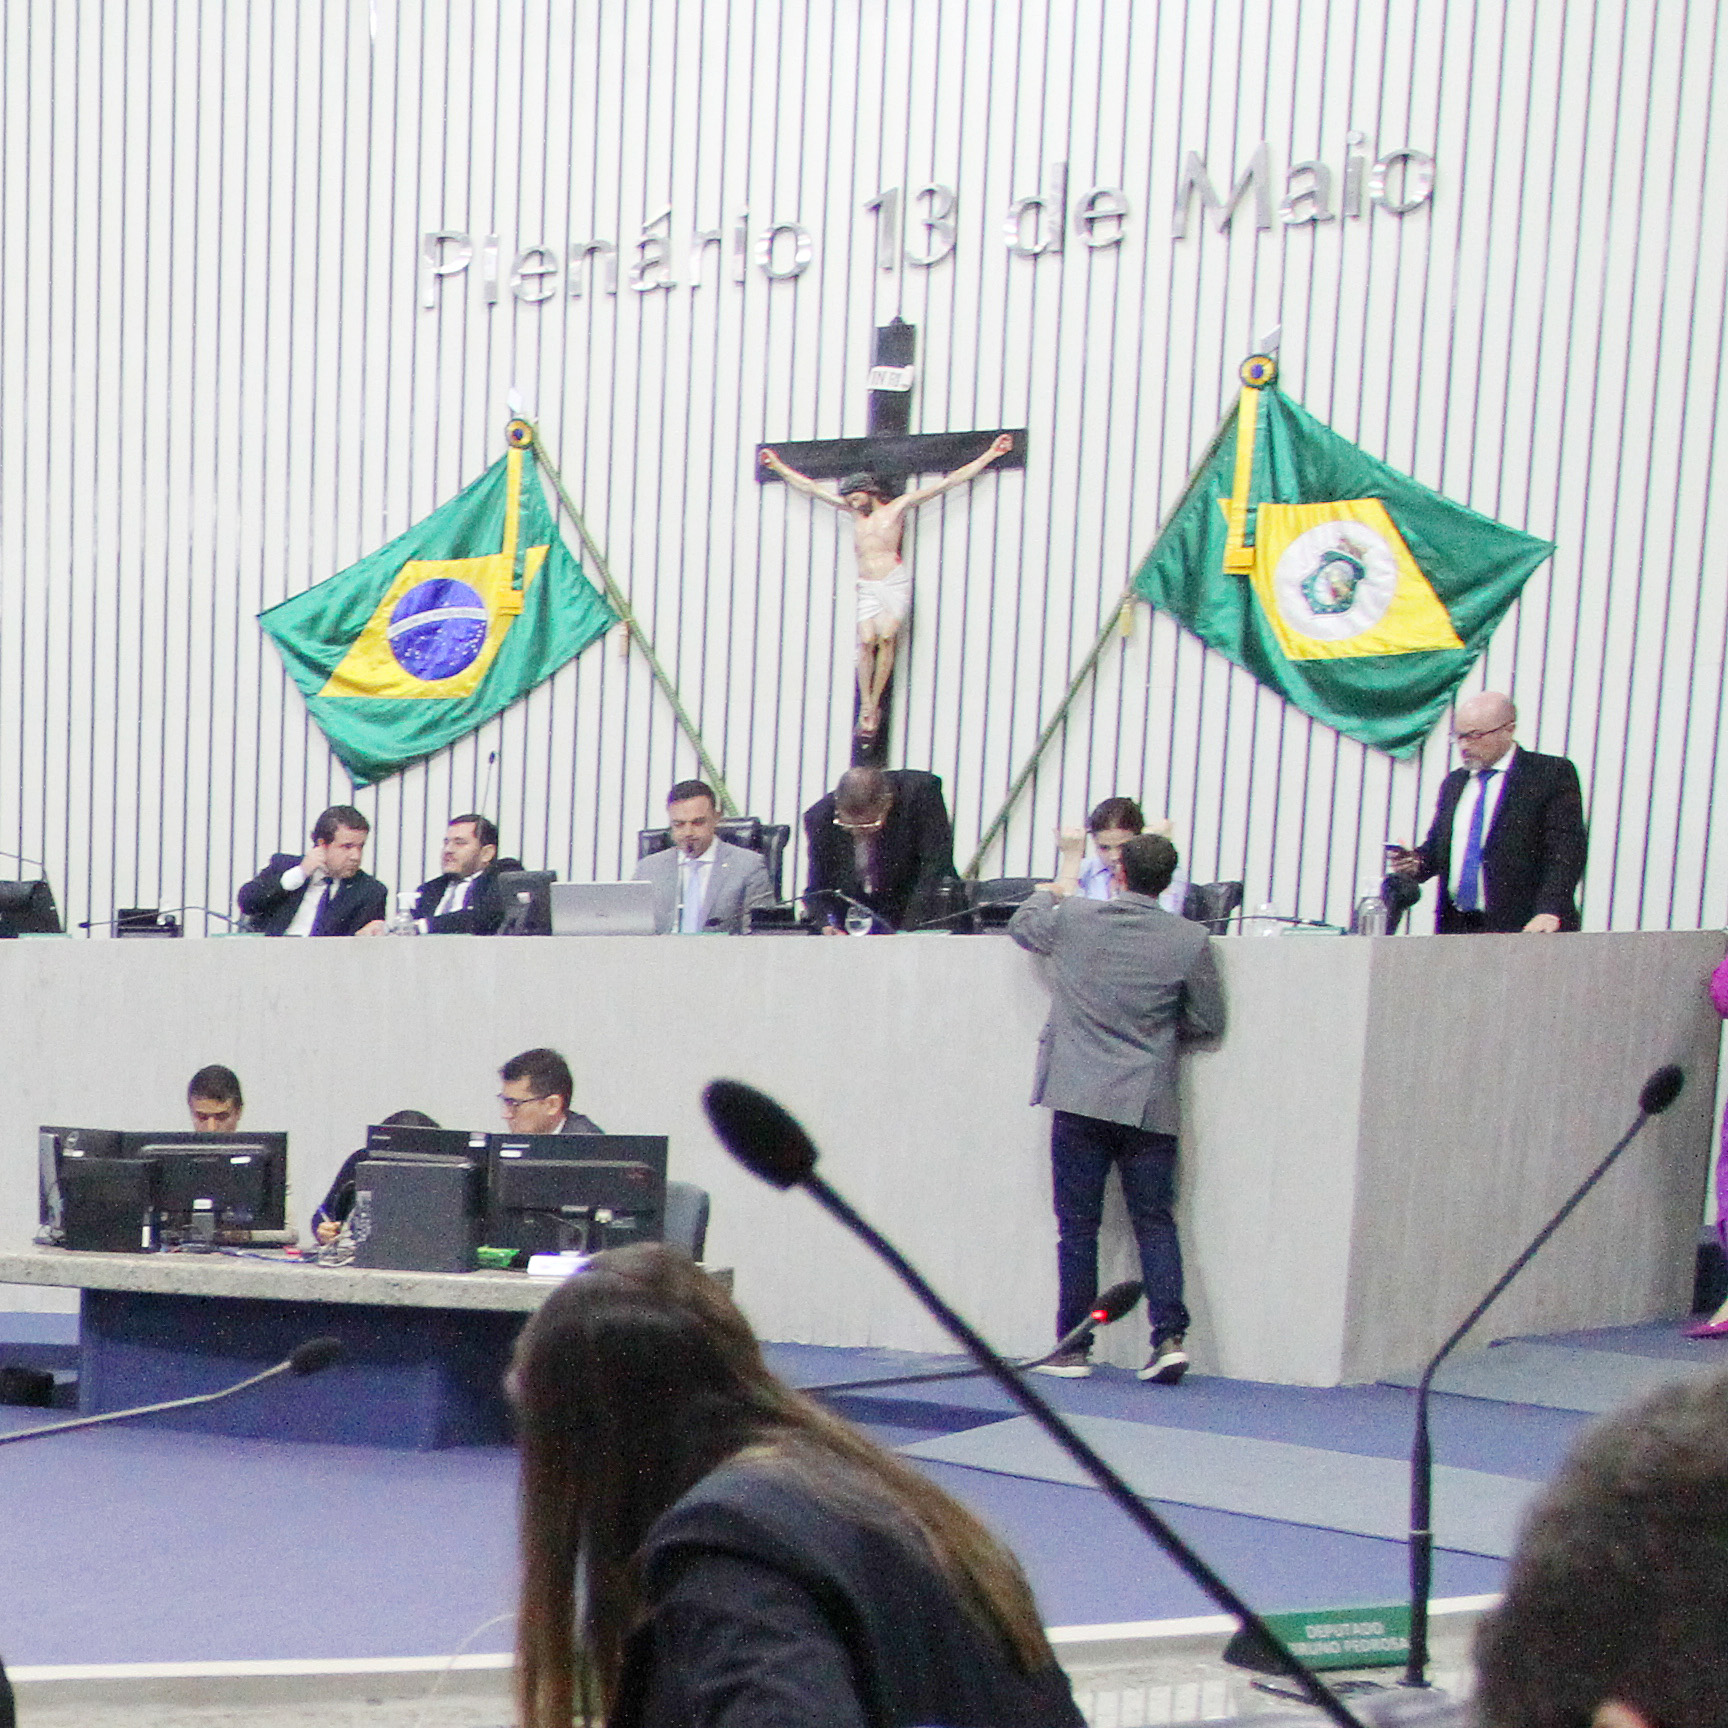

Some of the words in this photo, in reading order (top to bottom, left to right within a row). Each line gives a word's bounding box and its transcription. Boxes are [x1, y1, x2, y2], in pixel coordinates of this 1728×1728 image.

[423, 203, 813, 309] Plenário
[864, 181, 957, 271] 13
[1002, 160, 1131, 258] de
[1171, 129, 1437, 240] Maio
